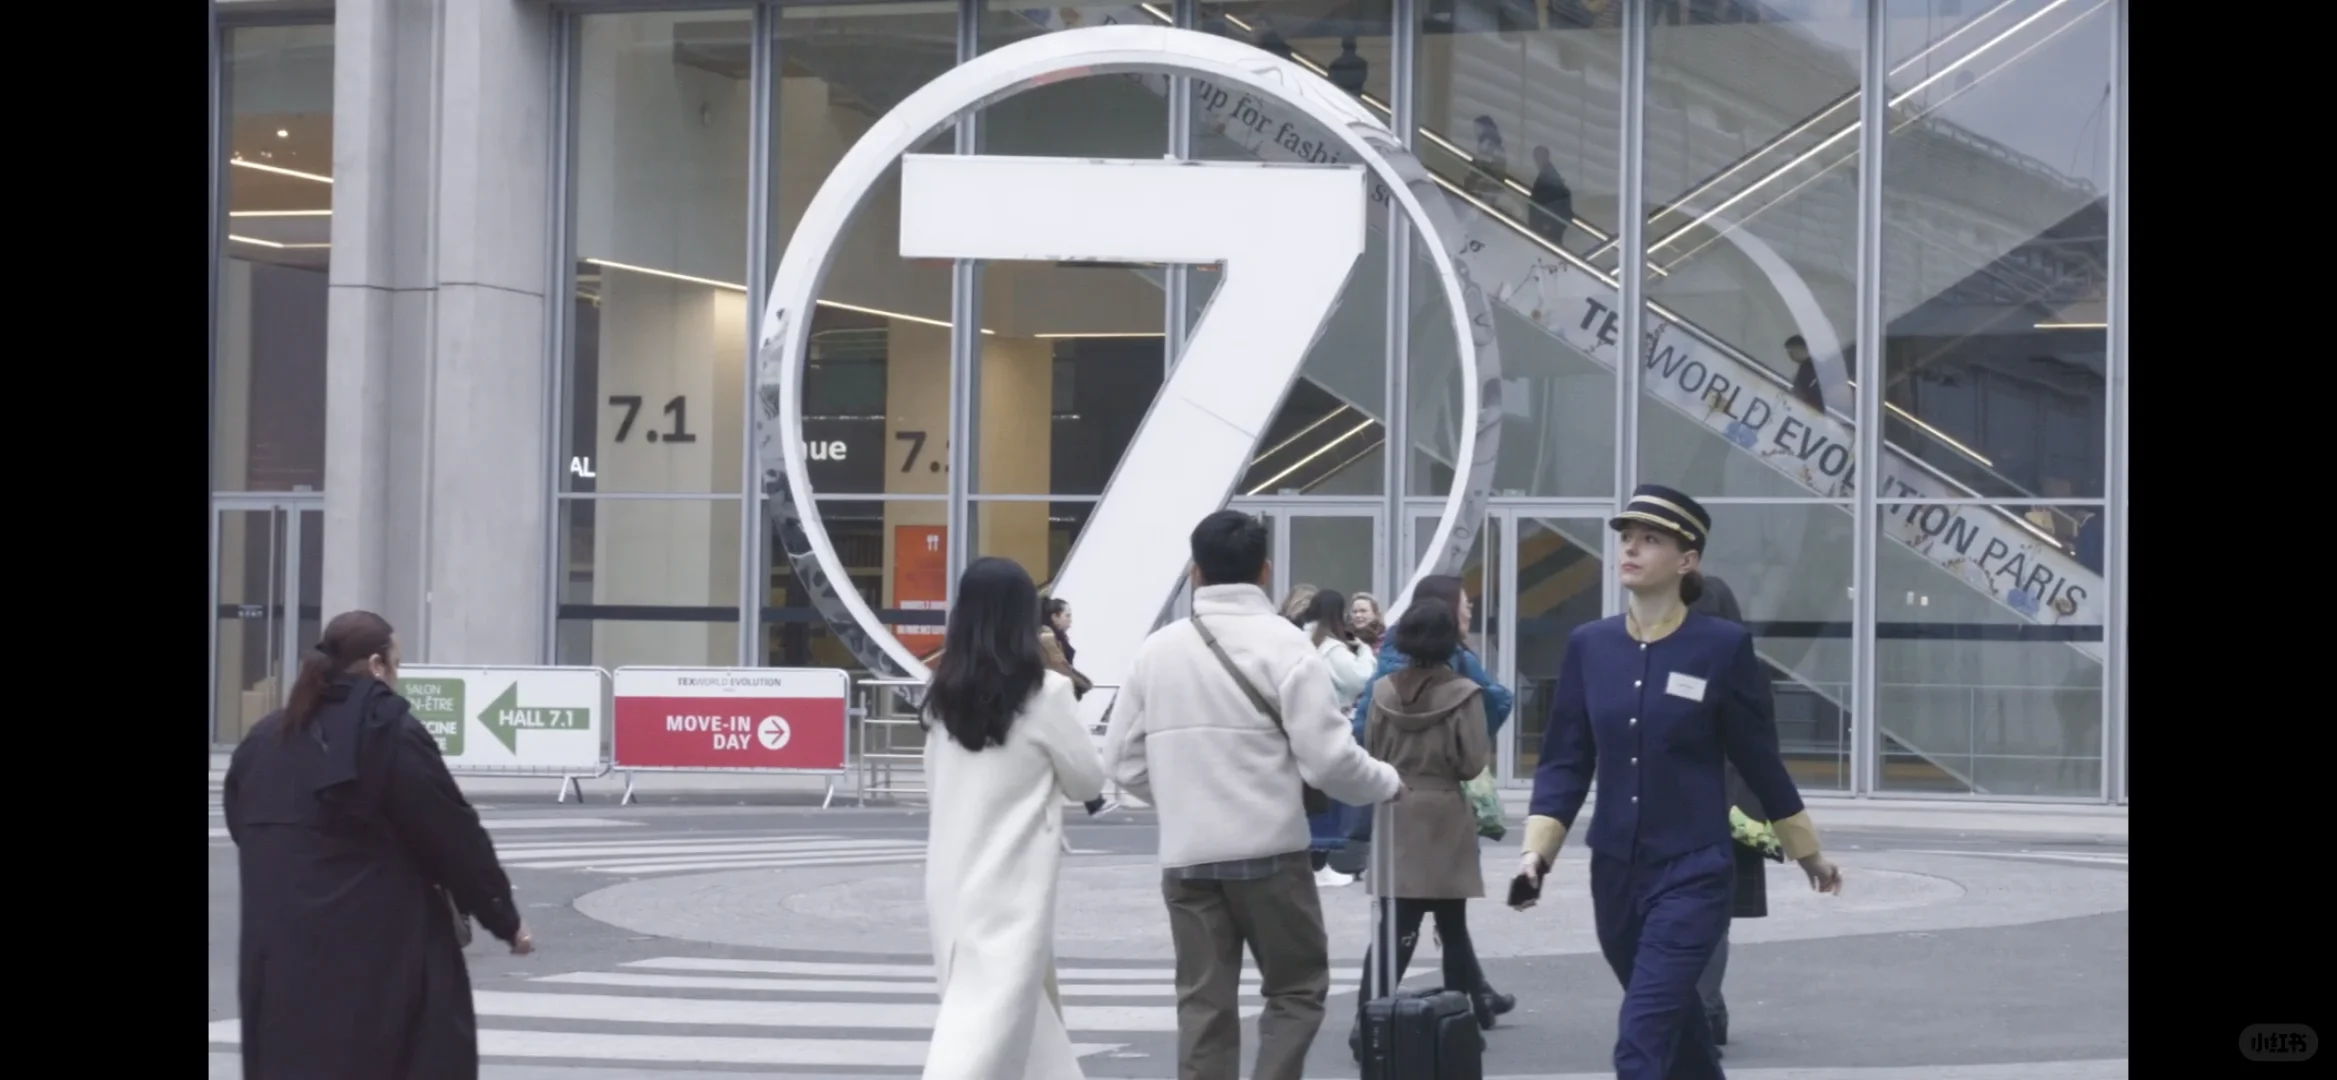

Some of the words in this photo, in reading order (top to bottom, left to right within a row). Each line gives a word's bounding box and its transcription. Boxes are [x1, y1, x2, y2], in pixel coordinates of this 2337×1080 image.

[1231, 94, 1272, 133] for
[1274, 122, 1340, 163] fashi
[608, 395, 696, 443] 7.1
[901, 154, 1366, 690] 7
[896, 431, 949, 473] 7.
[1580, 297, 1772, 431] TEWORLD
[1978, 537, 2087, 616] PARIS
[405, 683, 441, 695] SALON
[677, 677, 728, 687] TEXWORLD
[730, 677, 782, 687] EVOLUTION
[499, 710, 544, 727] HALL
[549, 710, 574, 727] 7.1
[666, 715, 751, 731] MOVE-IN
[421, 720, 457, 735] CINE
[713, 733, 751, 749] DAY
